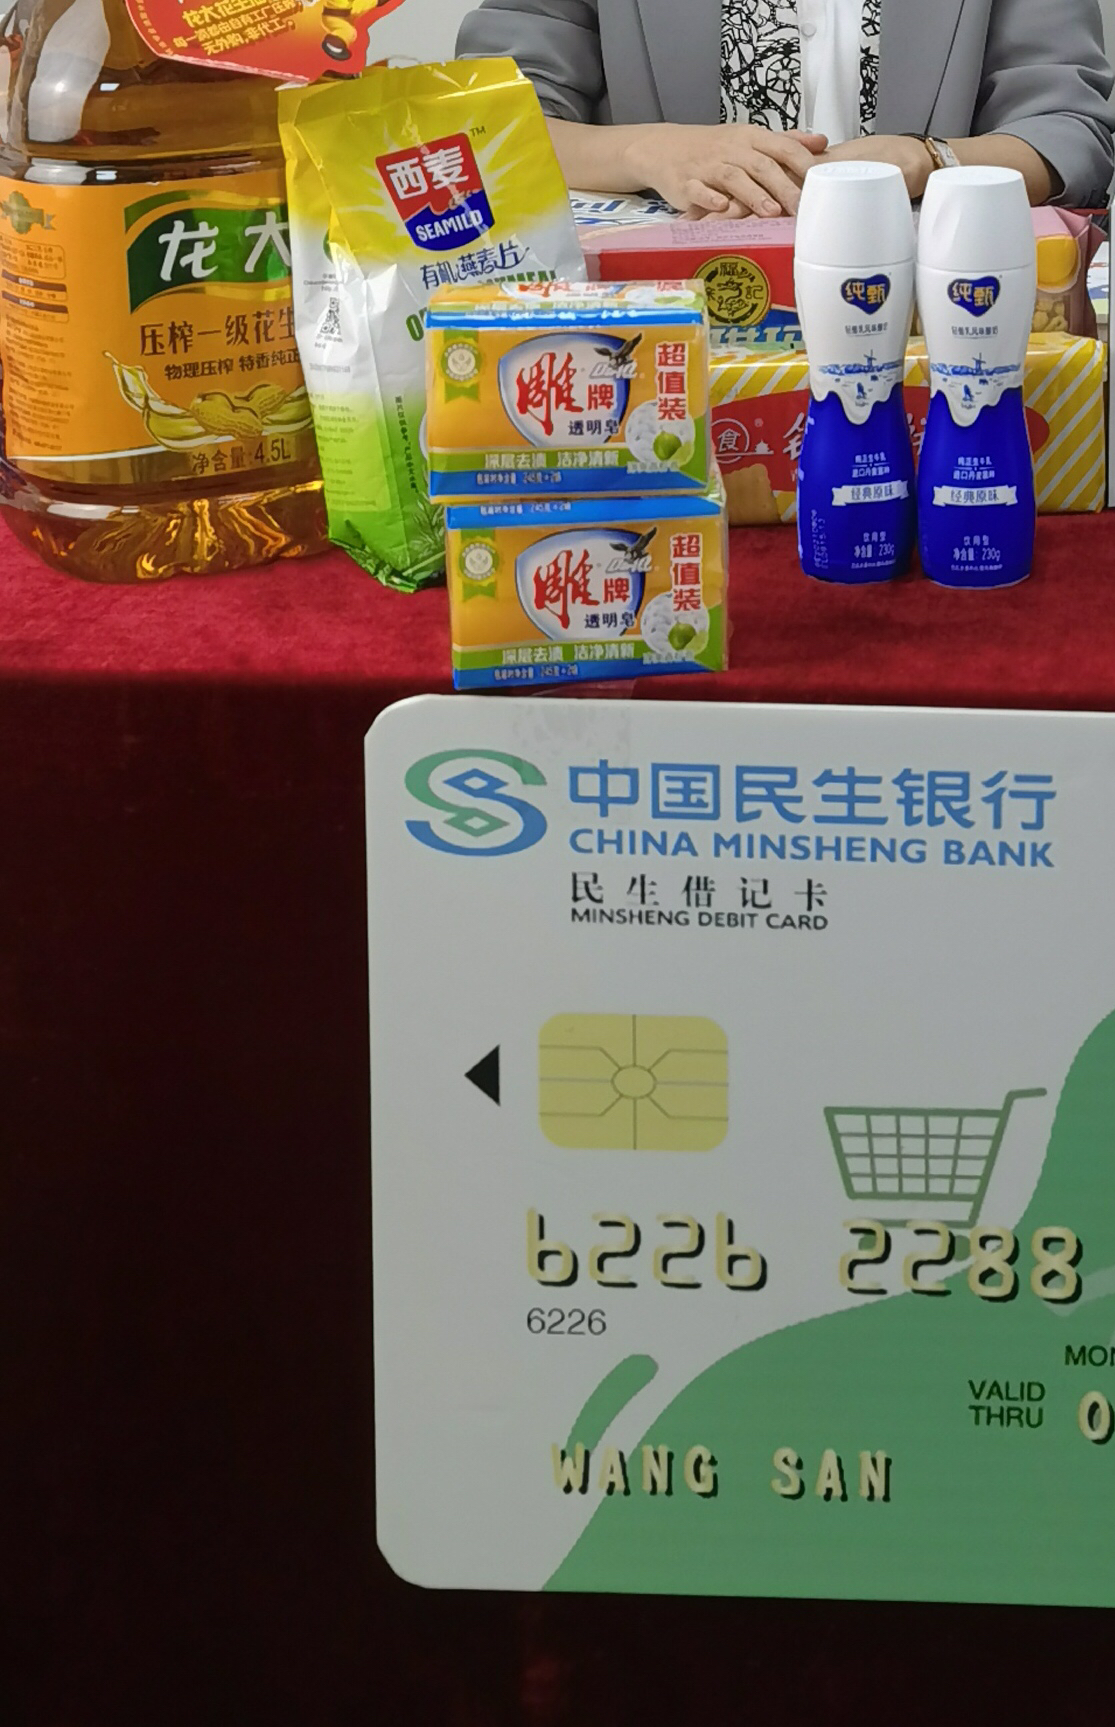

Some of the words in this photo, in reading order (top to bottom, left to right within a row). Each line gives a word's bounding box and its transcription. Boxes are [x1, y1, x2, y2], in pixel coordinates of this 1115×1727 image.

[385, 145, 470, 201] 西麦
[414, 208, 484, 243] SEAMILD
[158, 210, 291, 283] 龙大
[844, 281, 887, 304] 纯甄
[952, 281, 995, 307] 纯甄
[657, 342, 687, 421] 超值装
[568, 419, 620, 436] 透明皂
[850, 483, 896, 501] 经典原味
[950, 487, 1000, 504] 经典原味
[670, 534, 701, 613] 超值装
[584, 612, 636, 629] 透明皂
[568, 759, 1057, 832] 中国民生银行
[568, 828, 698, 857] CHINA
[713, 833, 928, 864] MINSHENG
[943, 839, 1056, 868] BANK
[570, 871, 829, 911] 民生借记卡
[570, 908, 691, 928] MINSHENG
[697, 910, 758, 929] DEBIT
[765, 913, 829, 932] CARD
[838, 1218, 1083, 1304] 2288
[526, 1308, 607, 1335] 6226
[968, 1380, 1046, 1403] VALID
[968, 1405, 1044, 1429] THRU
[552, 1442, 719, 1498] WANG
[771, 1446, 892, 1503] SAN
